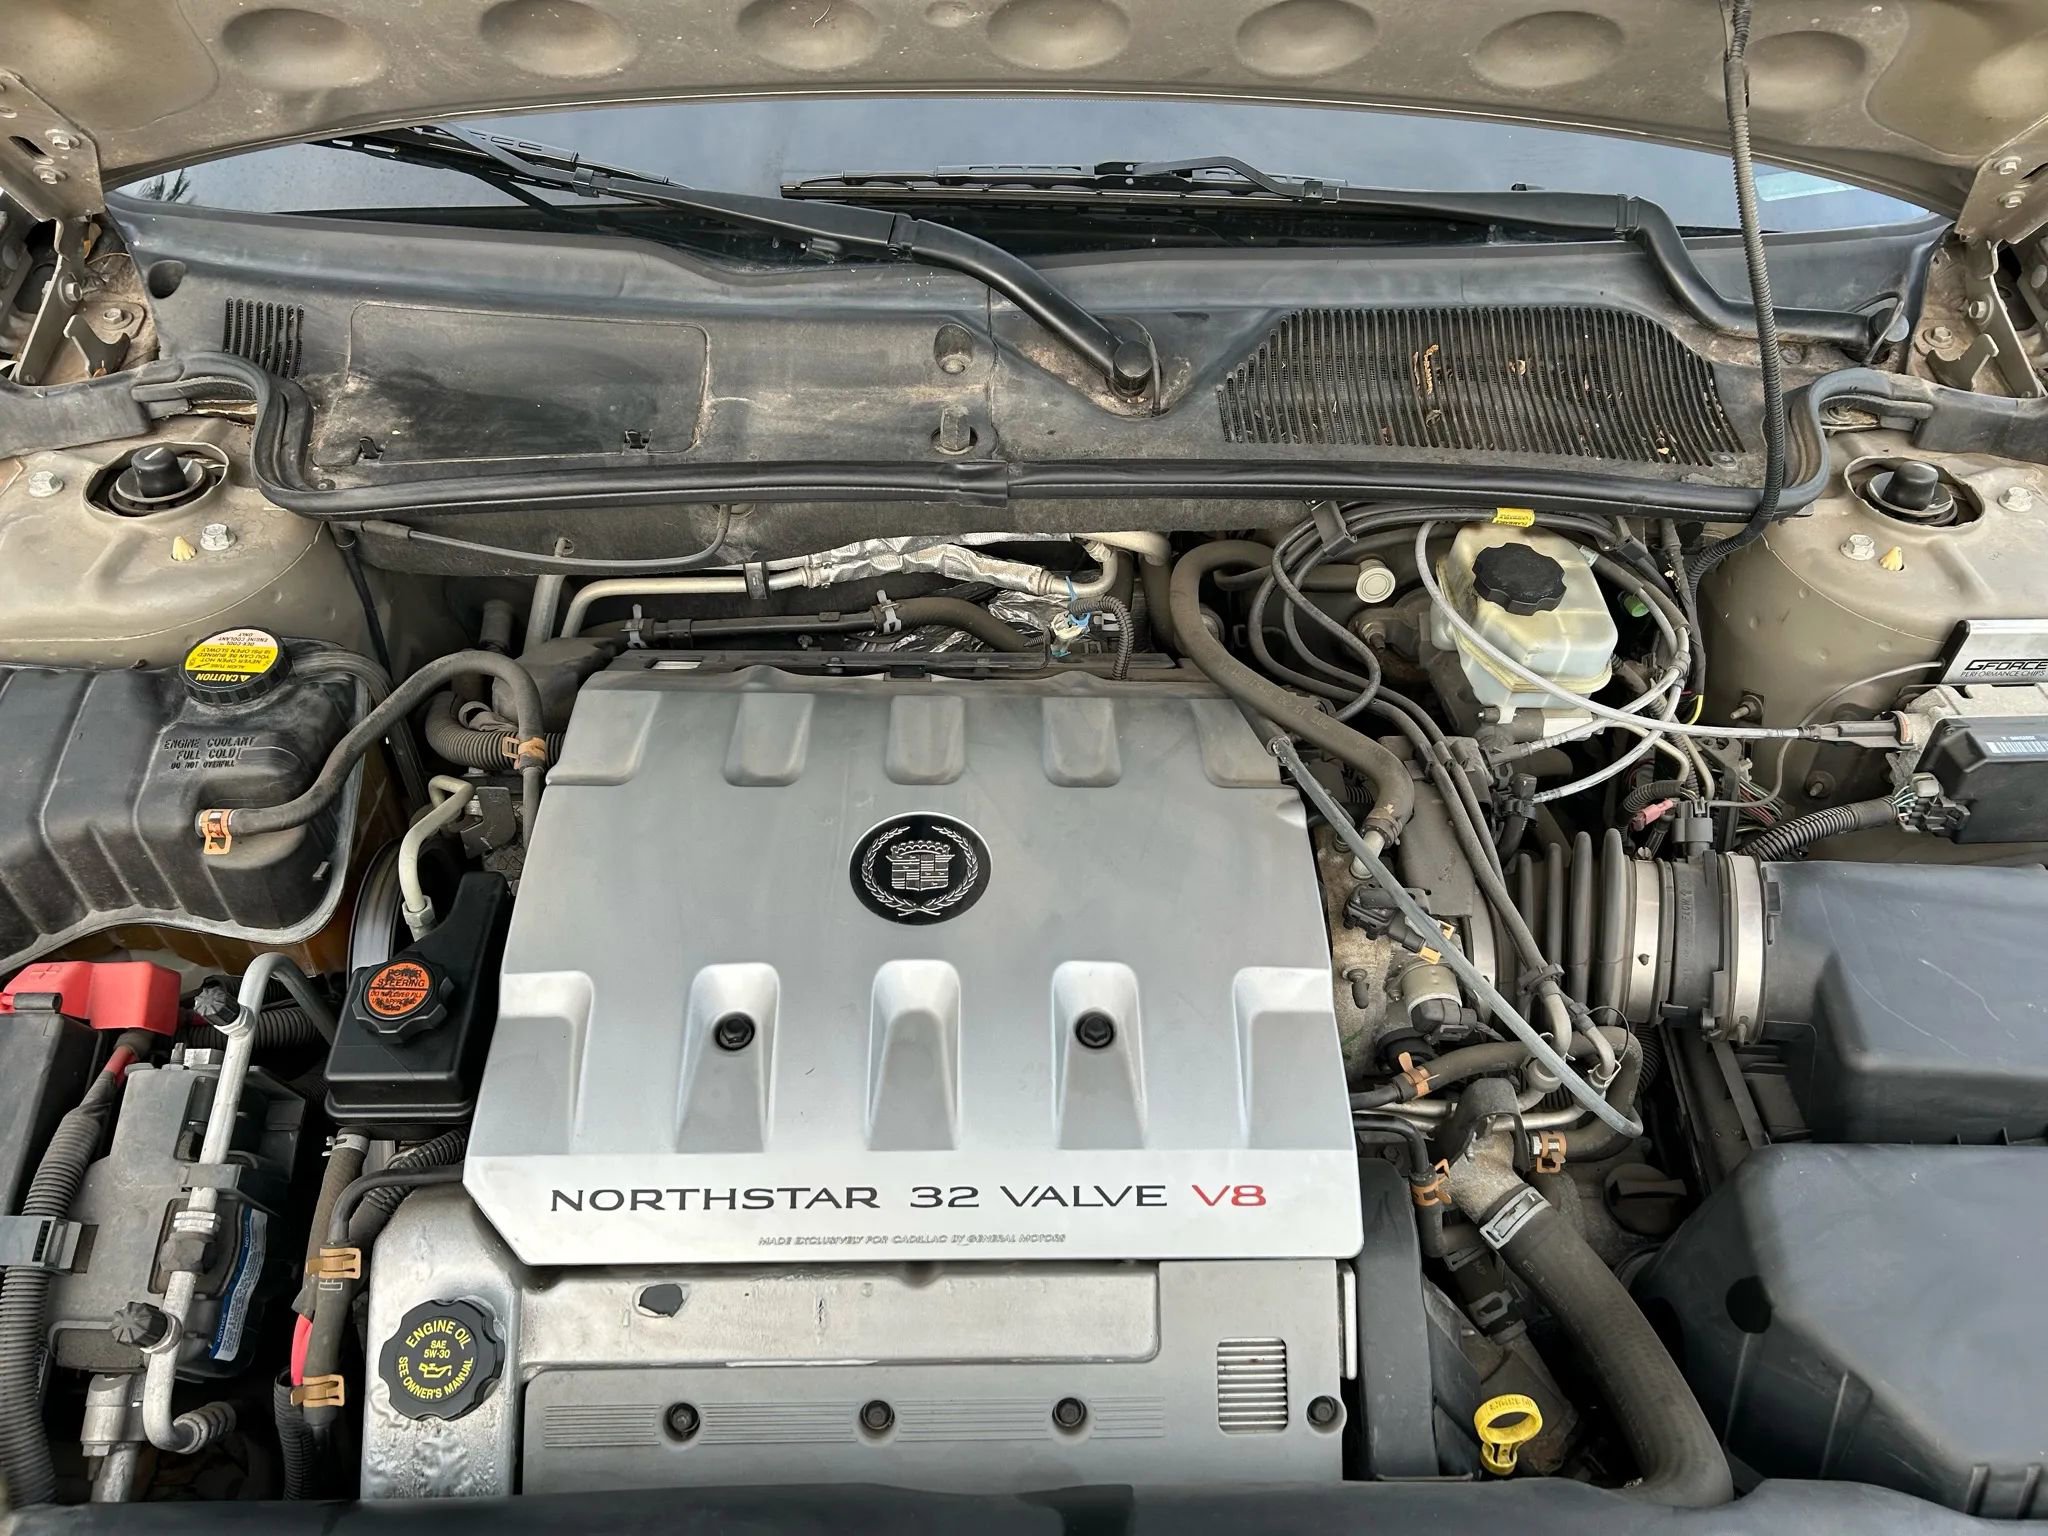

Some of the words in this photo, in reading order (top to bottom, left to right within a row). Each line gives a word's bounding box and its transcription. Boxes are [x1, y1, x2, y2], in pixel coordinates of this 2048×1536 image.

[1964, 659, 2048, 670] GFORCE
[196, 673, 238, 682] CAUTION
[164, 738, 200, 749] ENGINE
[207, 736, 256, 747] COOLANT
[176, 750, 200, 760] FULL
[208, 748, 236, 759] COLD
[202, 760, 234, 768] OVERFILL
[388, 968, 422, 978] POWR
[377, 979, 425, 987] STEERING
[551, 1187, 881, 1211] NORTHSTAR
[910, 1186, 979, 1207] 32
[1000, 1185, 1167, 1207] VALVE
[1191, 1184, 1266, 1206] V8
[758, 1236, 792, 1245] MADE
[794, 1236, 864, 1245] EXCLUSIVELY
[865, 1235, 889, 1244] FOR
[892, 1234, 948, 1244] CADILLAC
[967, 1234, 1016, 1243] GENERAL
[1018, 1234, 1066, 1242] MOTORS
[217, 1312, 227, 1342] NOTICE
[405, 1320, 456, 1348] ENGINE
[454, 1328, 471, 1350] OIL
[430, 1340, 447, 1349] SAE
[424, 1349, 451, 1358] 5W-30
[398, 1356, 410, 1378] SEE
[444, 1357, 474, 1395] MANUAL
[403, 1376, 442, 1399] OWNER'S
